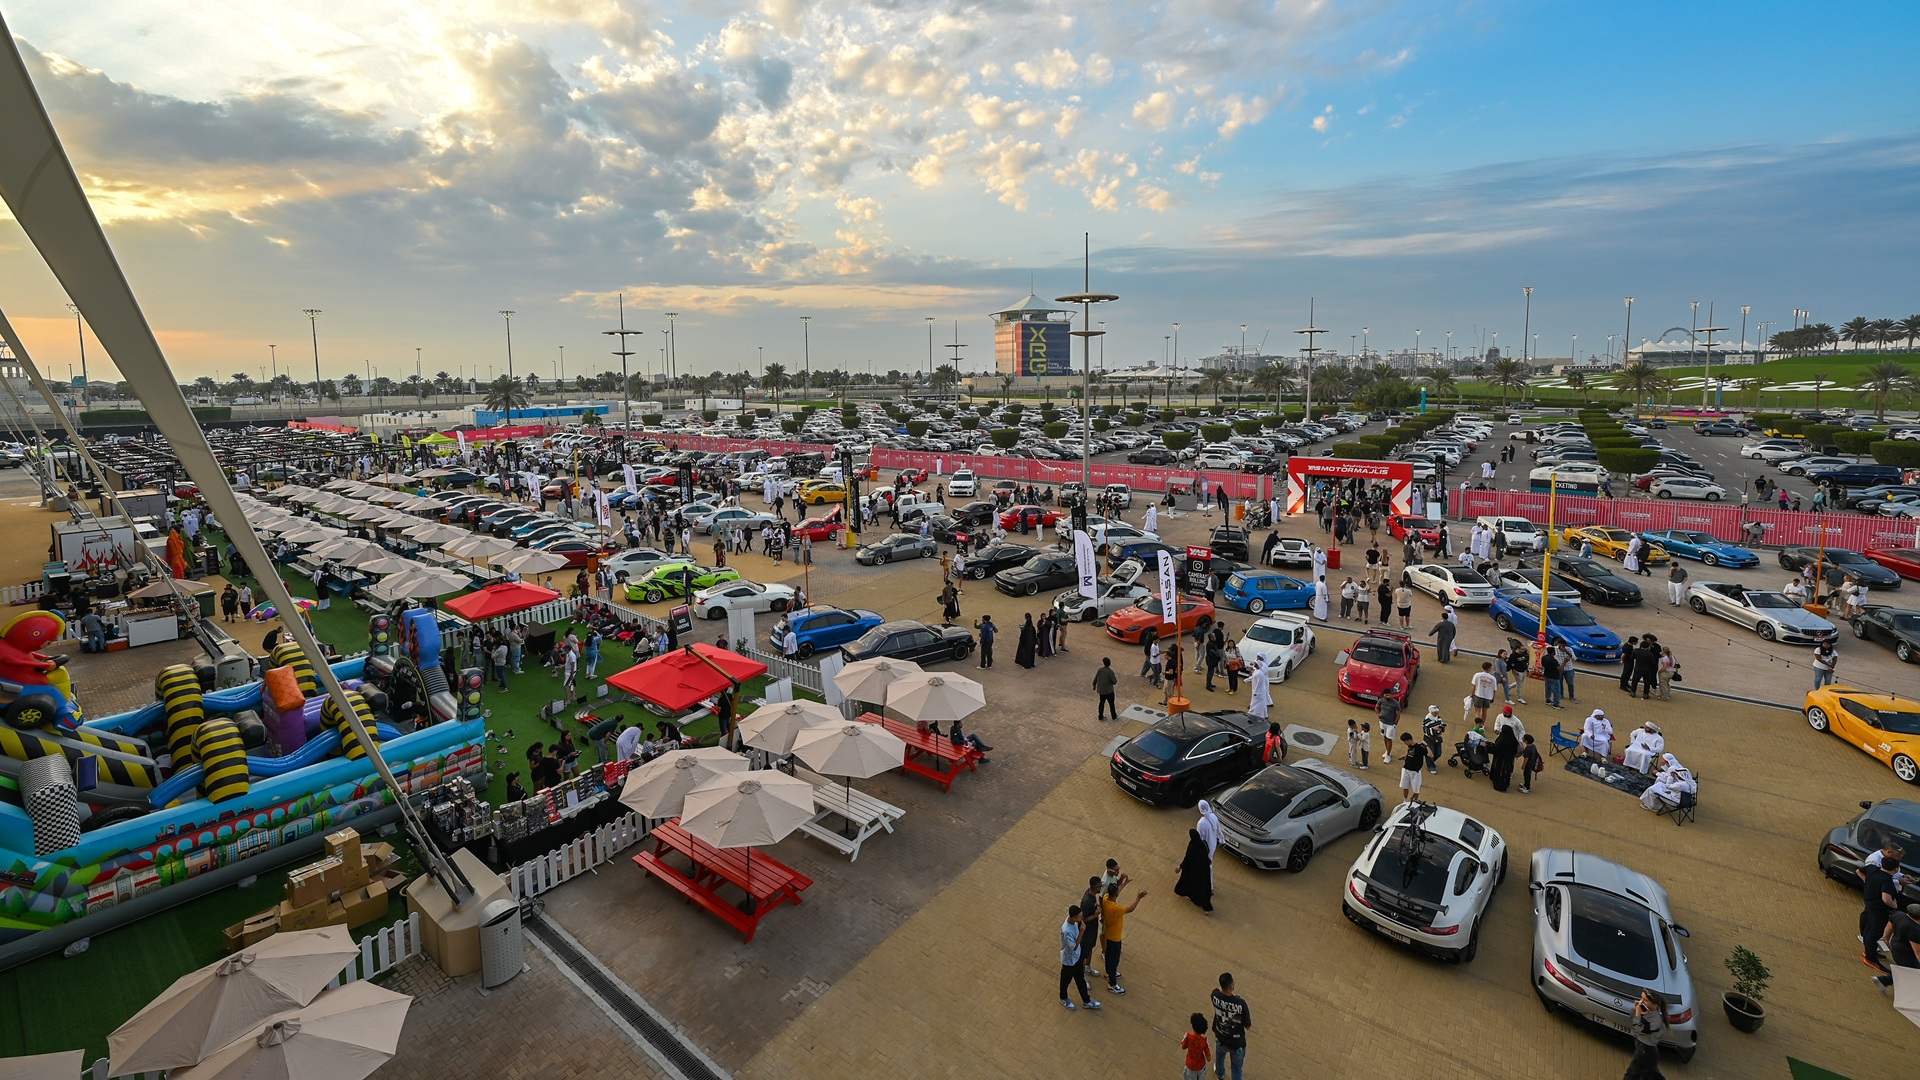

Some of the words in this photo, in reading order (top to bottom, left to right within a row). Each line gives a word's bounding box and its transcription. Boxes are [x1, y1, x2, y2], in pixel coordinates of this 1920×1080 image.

[1029, 327, 1047, 373] XRG
[1555, 482, 1578, 490] CKETING
[1189, 547, 1208, 557] YAS
[1163, 556, 1173, 618] NISSAN
